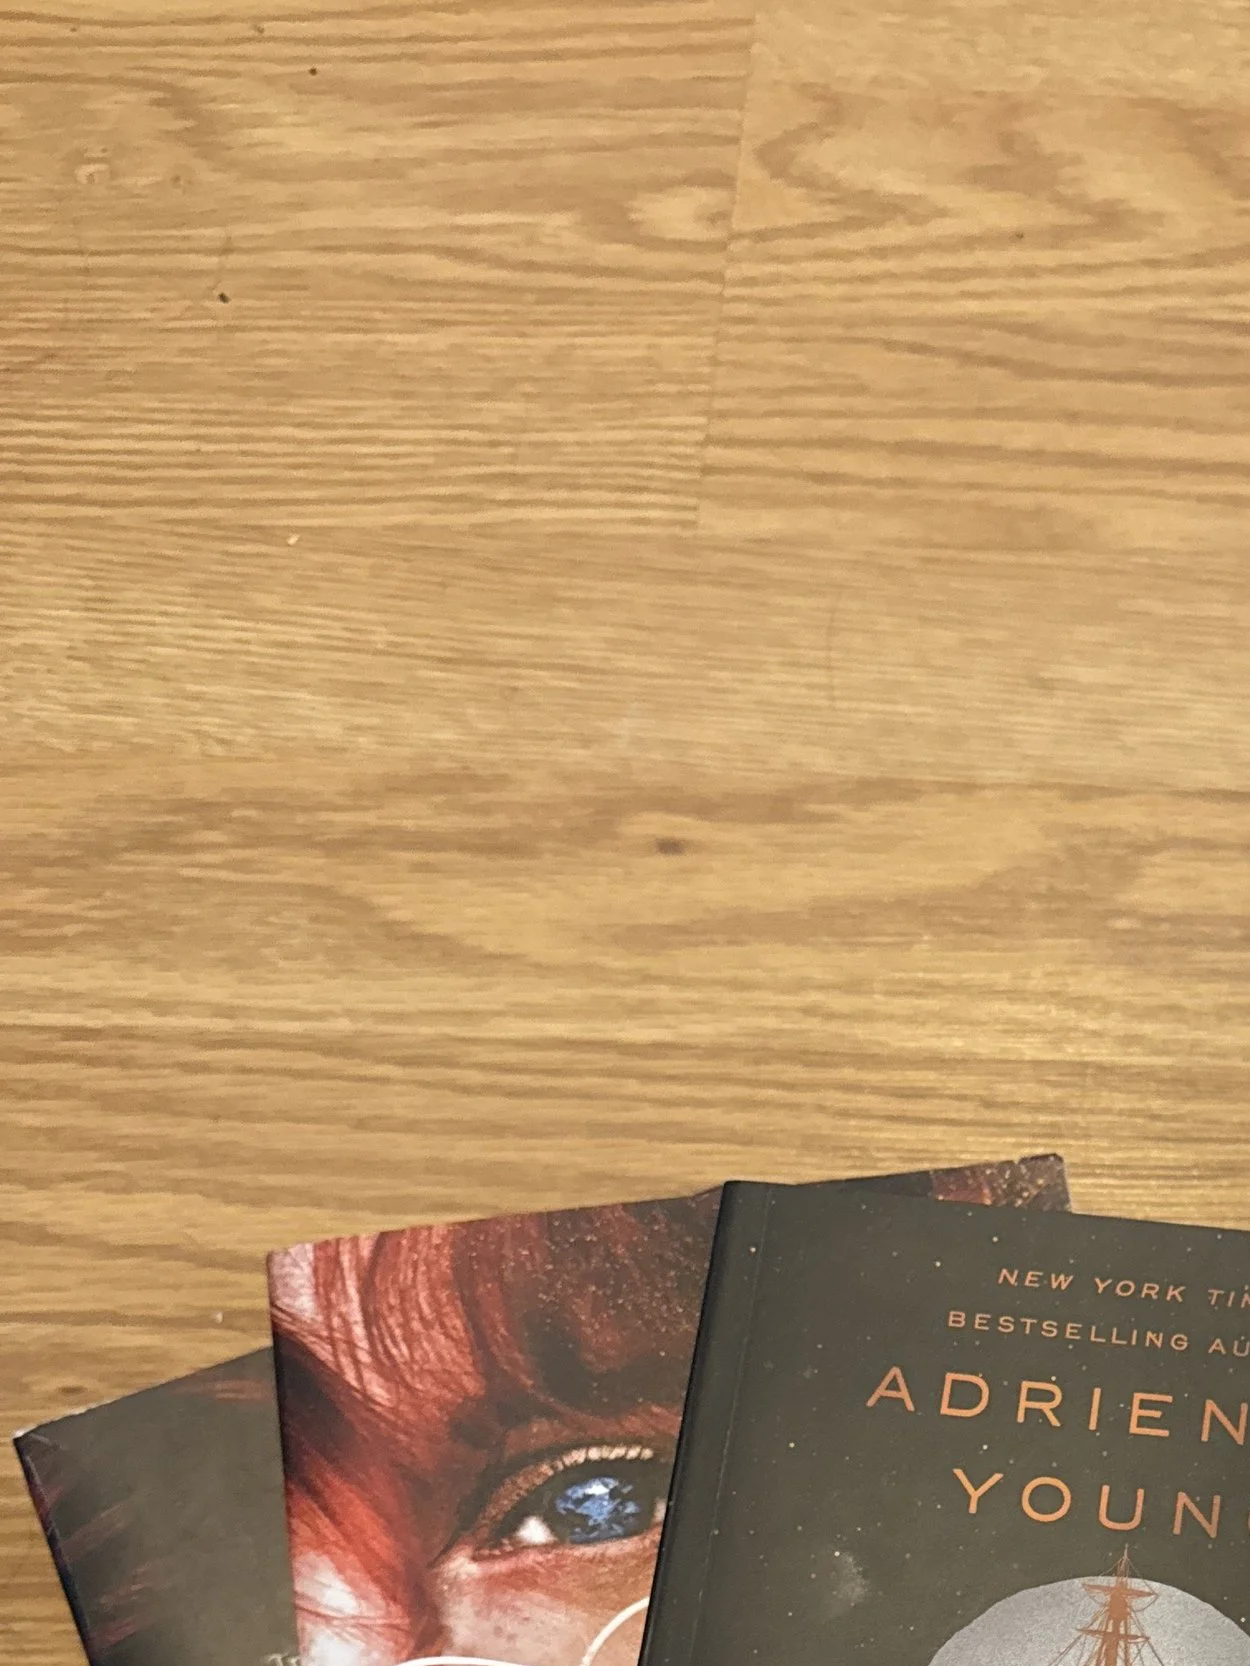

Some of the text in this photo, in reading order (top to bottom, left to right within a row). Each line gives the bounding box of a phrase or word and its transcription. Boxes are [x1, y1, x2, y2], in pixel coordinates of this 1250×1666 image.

[999, 1267, 1073, 1291] NEW
[1094, 1276, 1187, 1303] YORK
[948, 1310, 1189, 1352] BESTSELLING
